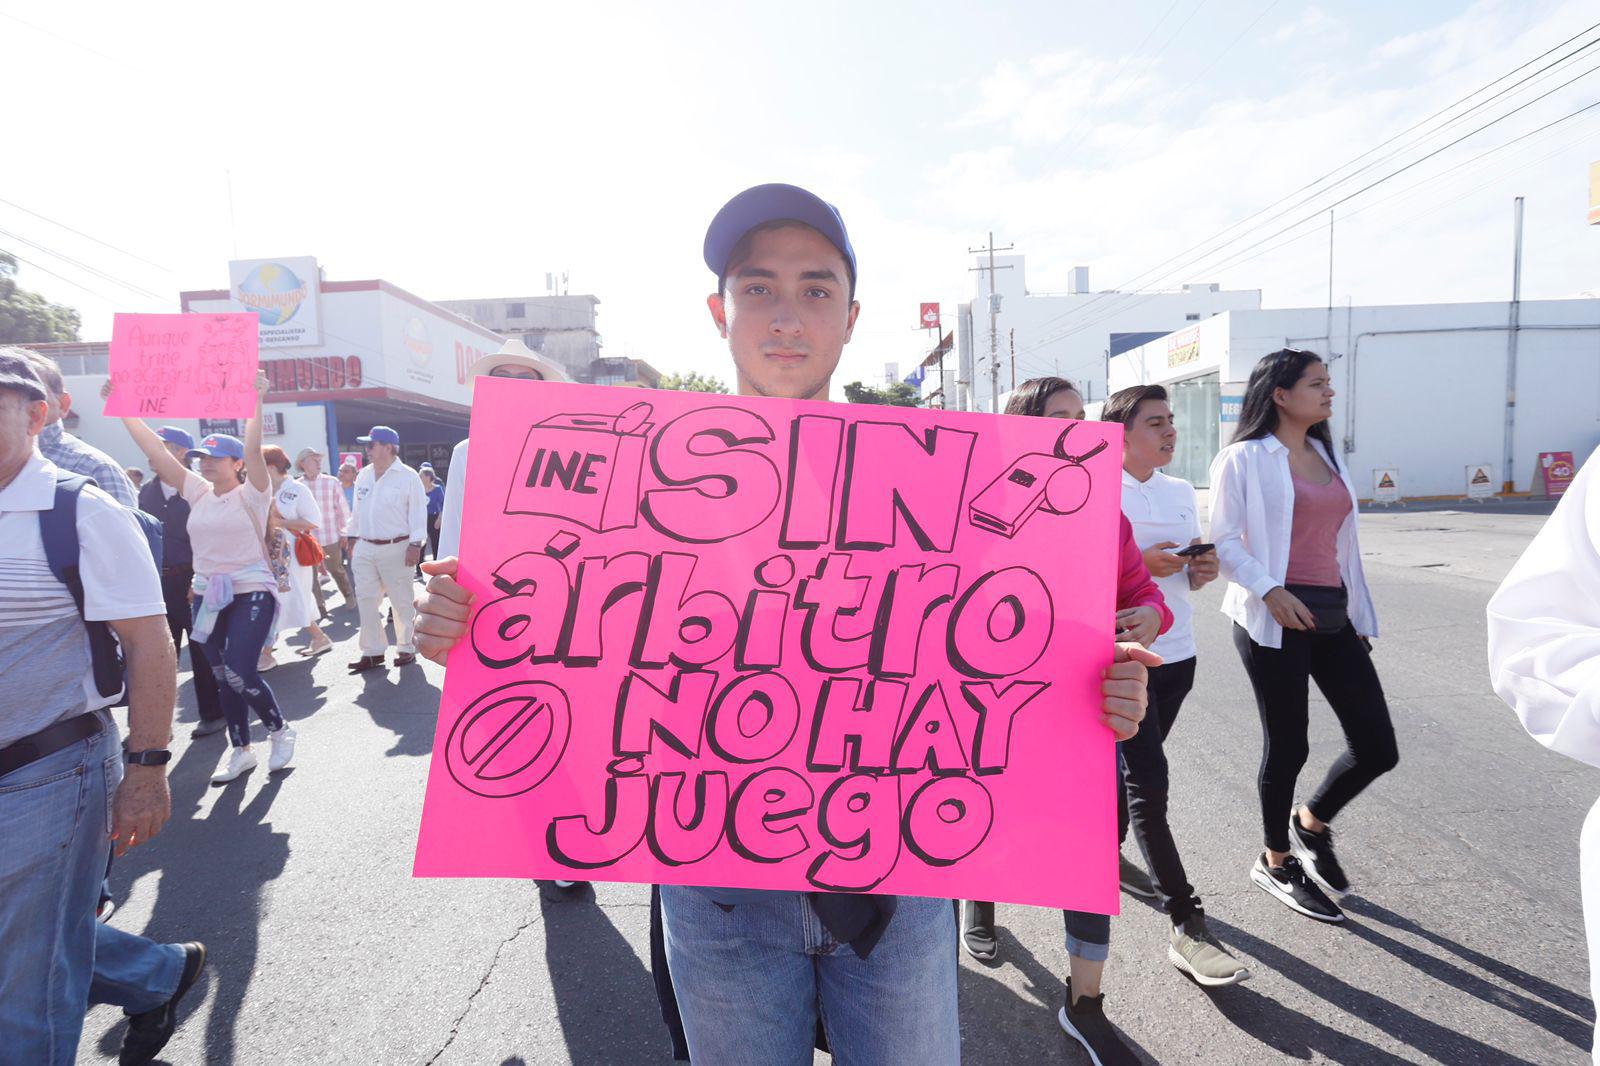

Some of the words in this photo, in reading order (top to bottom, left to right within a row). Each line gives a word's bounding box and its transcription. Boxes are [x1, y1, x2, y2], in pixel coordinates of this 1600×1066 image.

[128, 324, 190, 351] Aunque
[139, 397, 168, 413] INE
[525, 448, 607, 494] INE
[471, 530, 1054, 679] árbitro
[612, 669, 800, 764] NO
[806, 676, 1052, 776] HAY
[546, 754, 994, 892] juego
